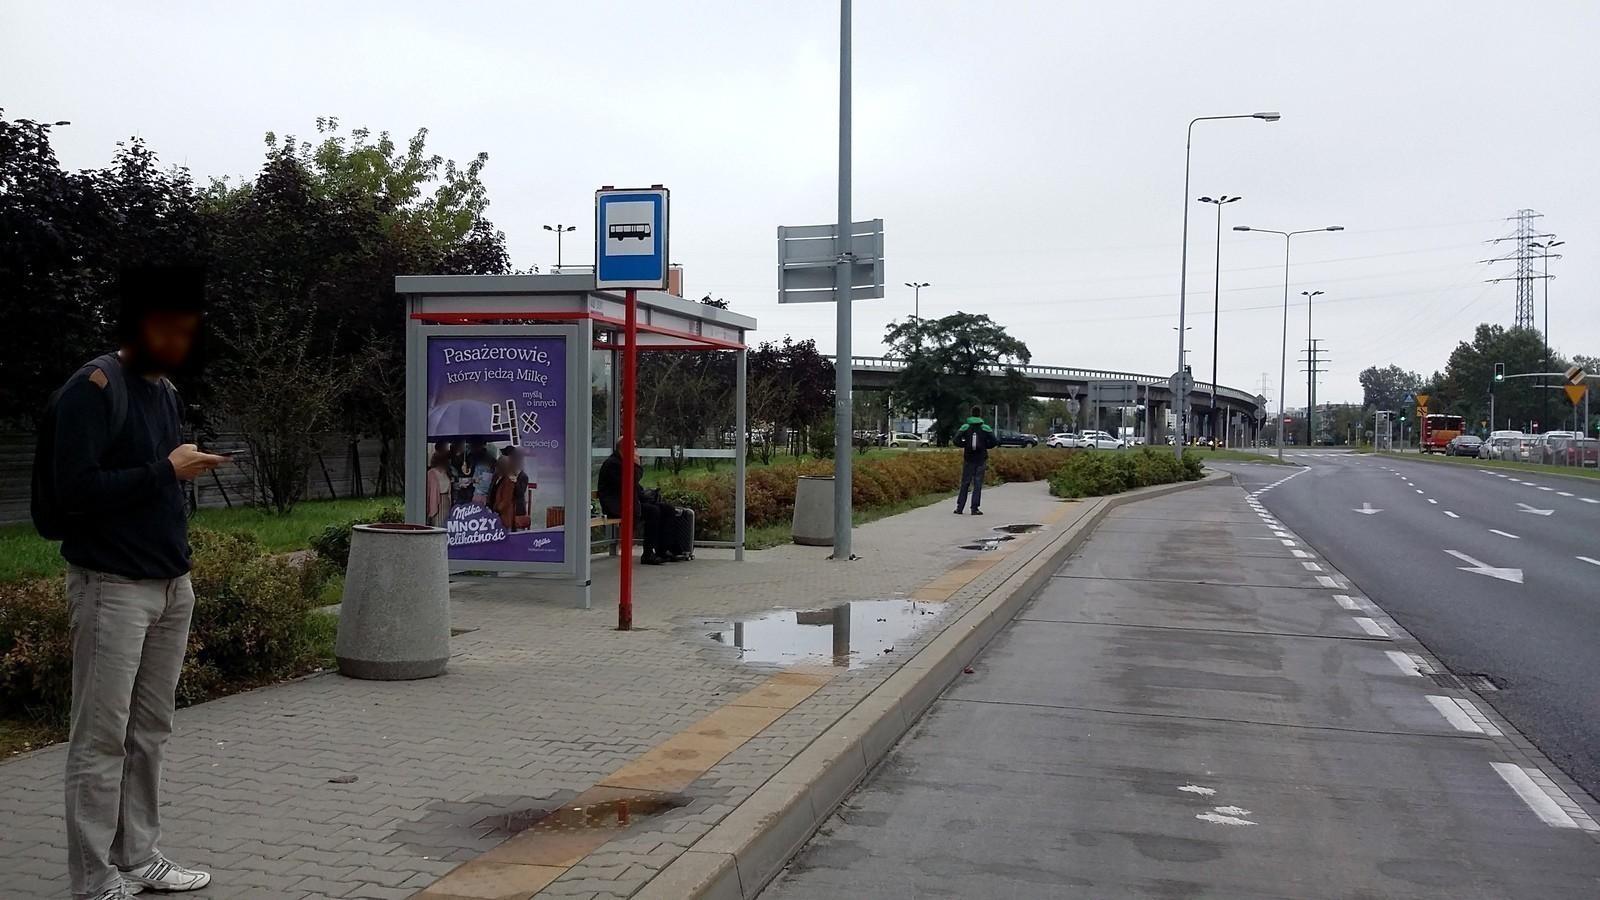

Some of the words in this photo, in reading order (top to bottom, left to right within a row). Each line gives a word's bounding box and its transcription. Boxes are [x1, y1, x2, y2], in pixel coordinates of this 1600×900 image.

[444, 344, 551, 366] Pasażerowie,
[447, 370, 482, 384] którzy
[484, 367, 514, 382] jedzą
[516, 368, 548, 385] Milkę
[533, 399, 557, 408] innych
[452, 504, 482, 520] Milka
